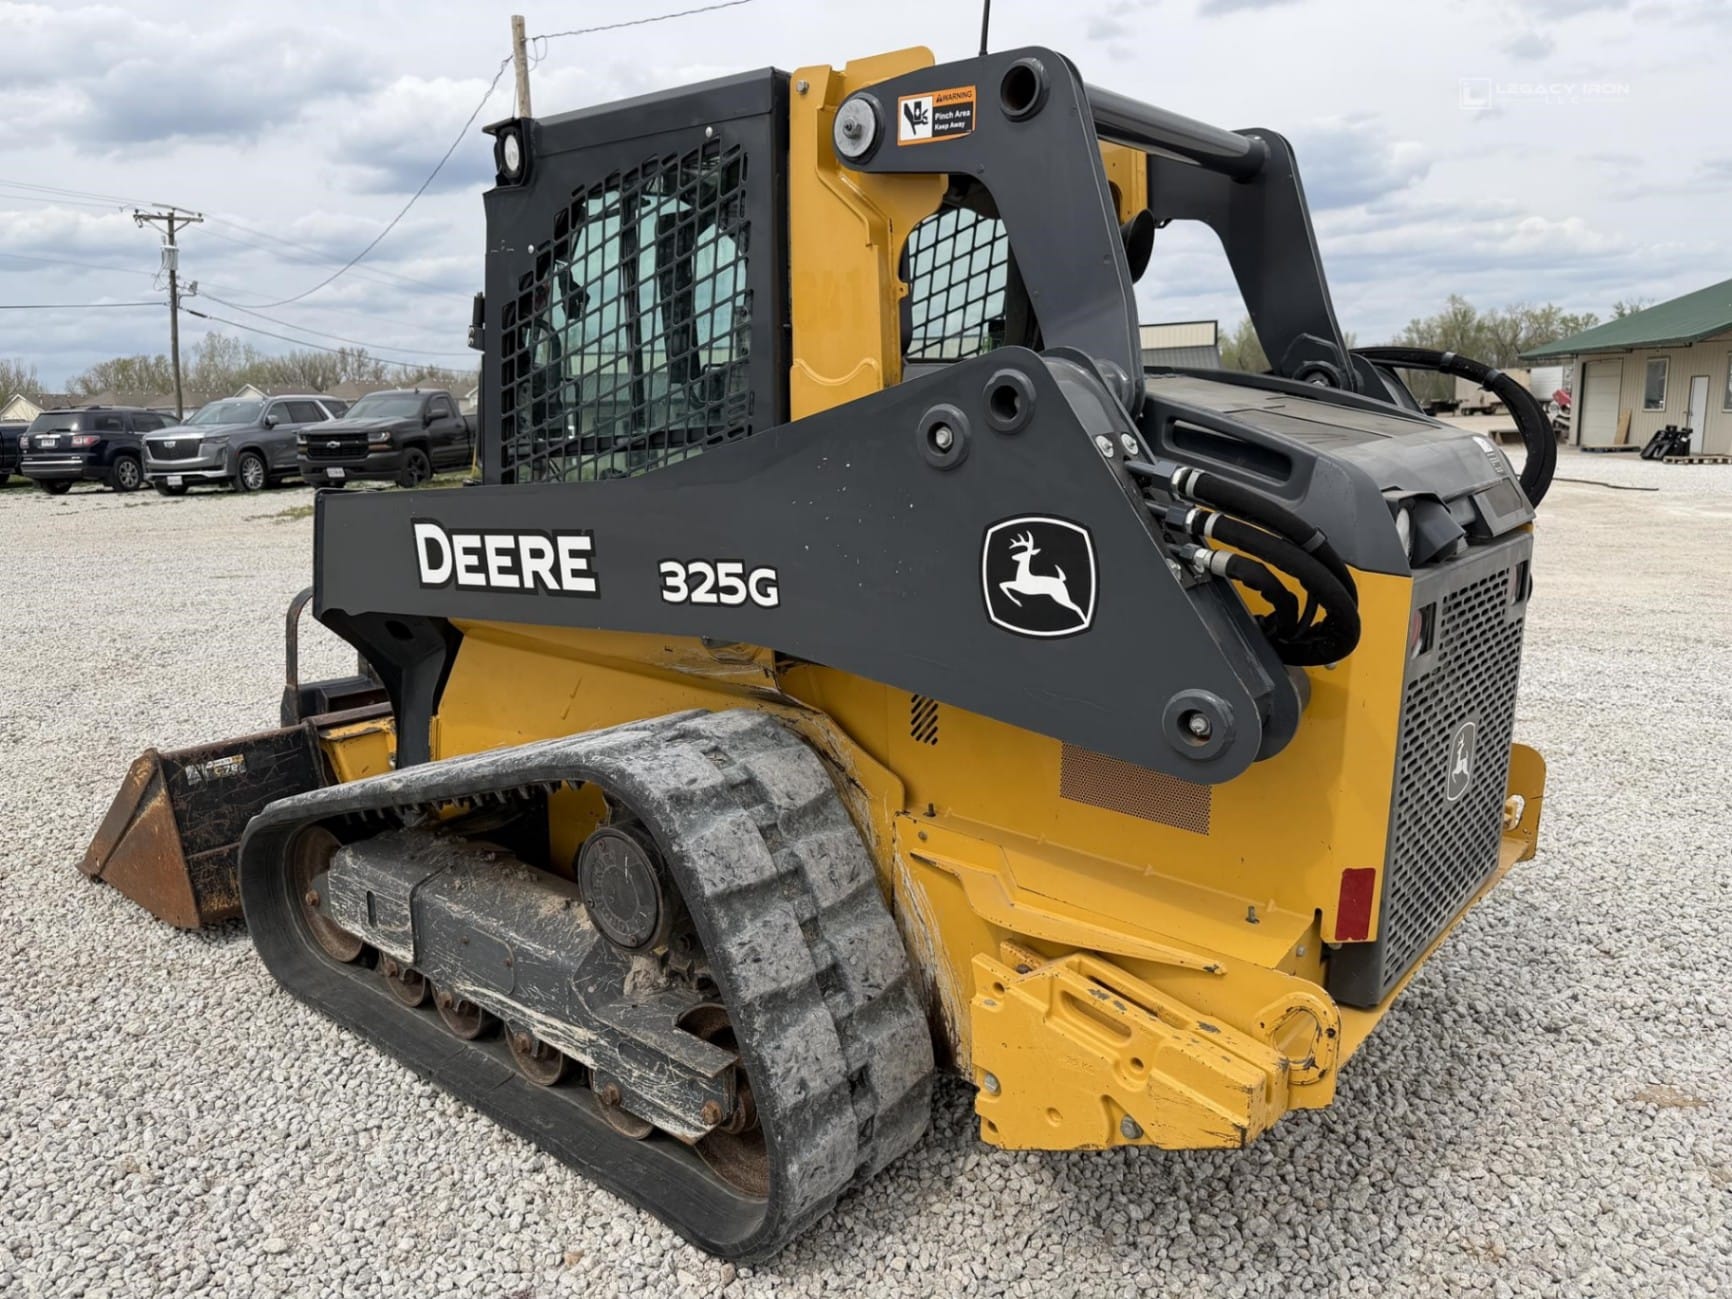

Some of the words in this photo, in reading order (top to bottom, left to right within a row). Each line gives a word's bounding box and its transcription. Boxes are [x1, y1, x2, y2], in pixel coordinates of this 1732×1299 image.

[942, 90, 972, 102] WARNING
[934, 111, 954, 121] Pinch
[954, 109, 971, 118] Area
[934, 122, 949, 131] Keep
[949, 120, 966, 130] Away
[413, 523, 597, 592] DEERE
[659, 560, 779, 607] 325G
